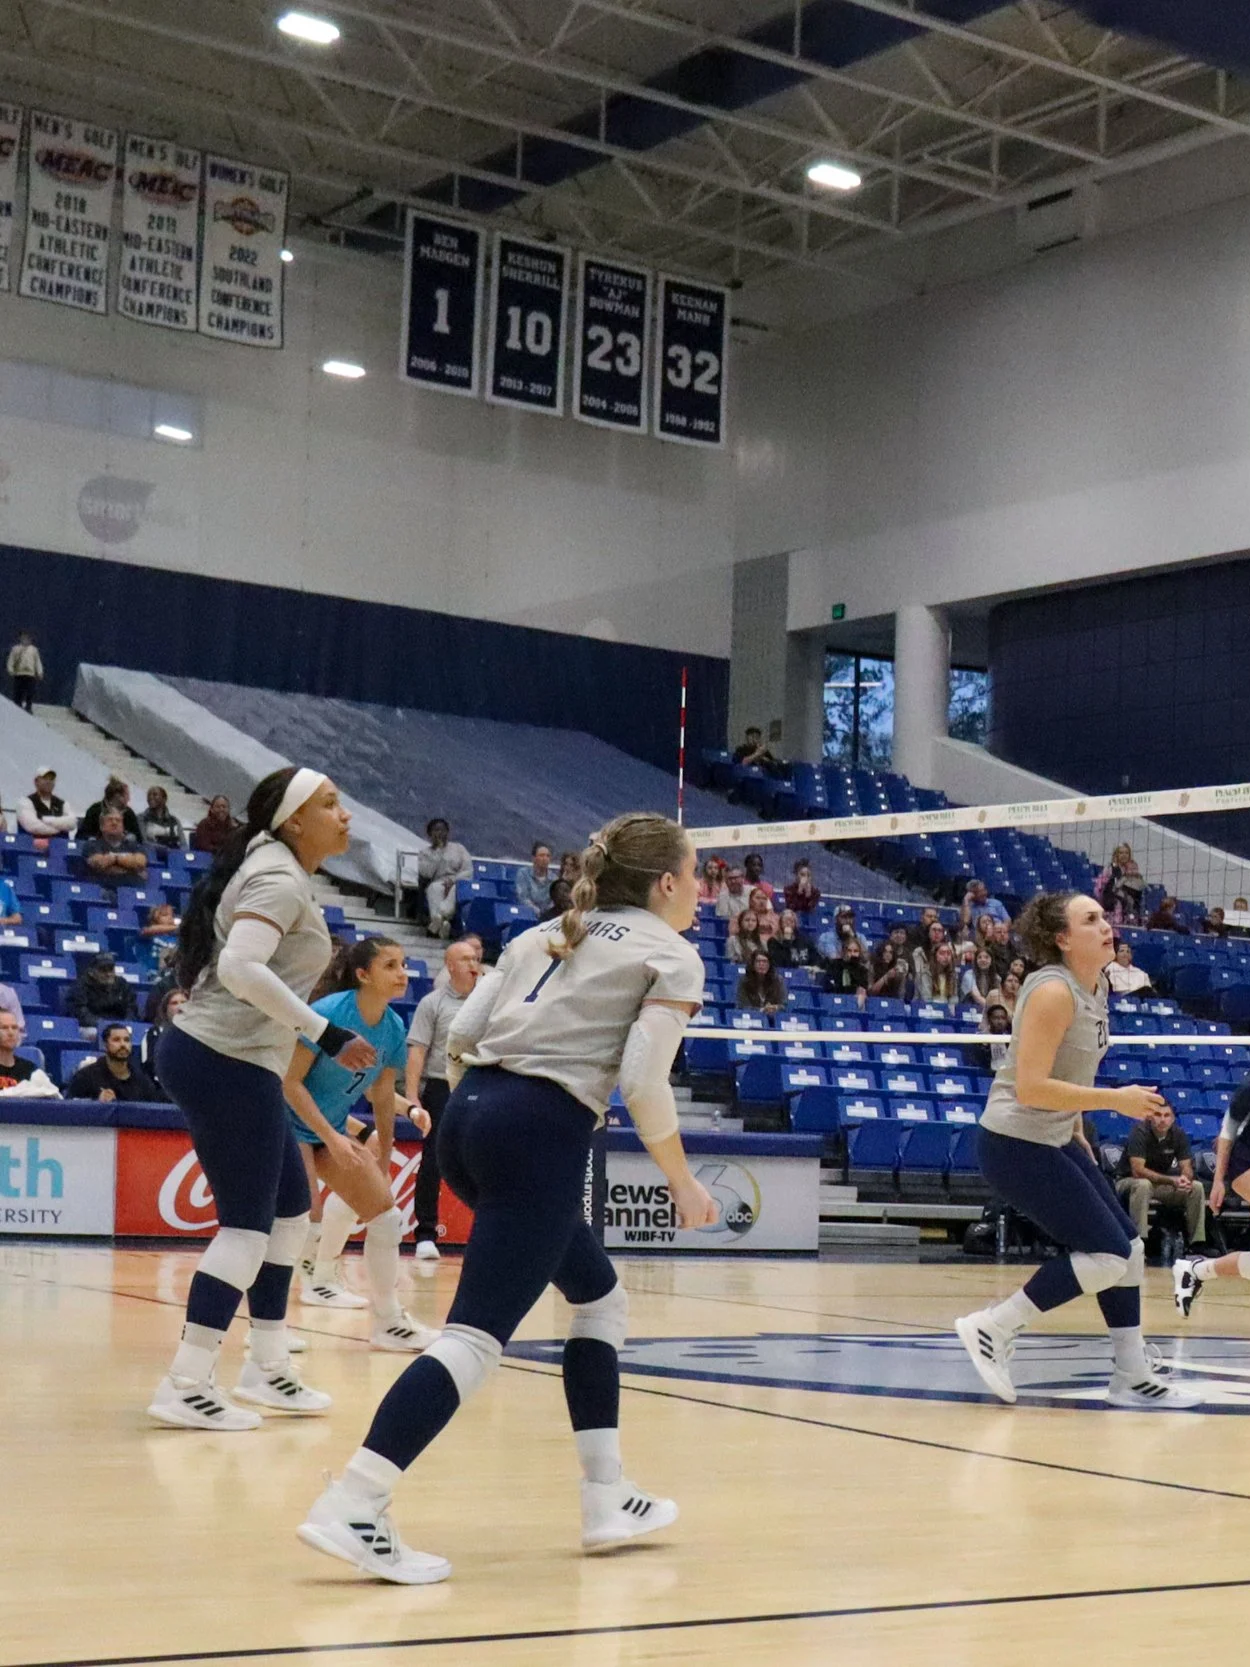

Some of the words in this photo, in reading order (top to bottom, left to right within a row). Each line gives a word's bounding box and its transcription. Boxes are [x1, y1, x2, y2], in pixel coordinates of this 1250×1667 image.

[39, 232, 99, 261] ATHLETIC
[28, 252, 104, 286] CONFERENCE
[29, 276, 99, 307] CHAMPIONS
[123, 295, 188, 326] CHAMPIONS
[208, 311, 274, 340] CHAMPIONS
[433, 288, 450, 334] 1
[506, 306, 552, 356] 10
[587, 325, 641, 377] 23
[666, 344, 719, 395] 32
[523, 956, 562, 1003] 1
[345, 1071, 366, 1094] 7
[726, 1210, 753, 1223] abc
[624, 1230, 676, 1243] WJBF-TV
